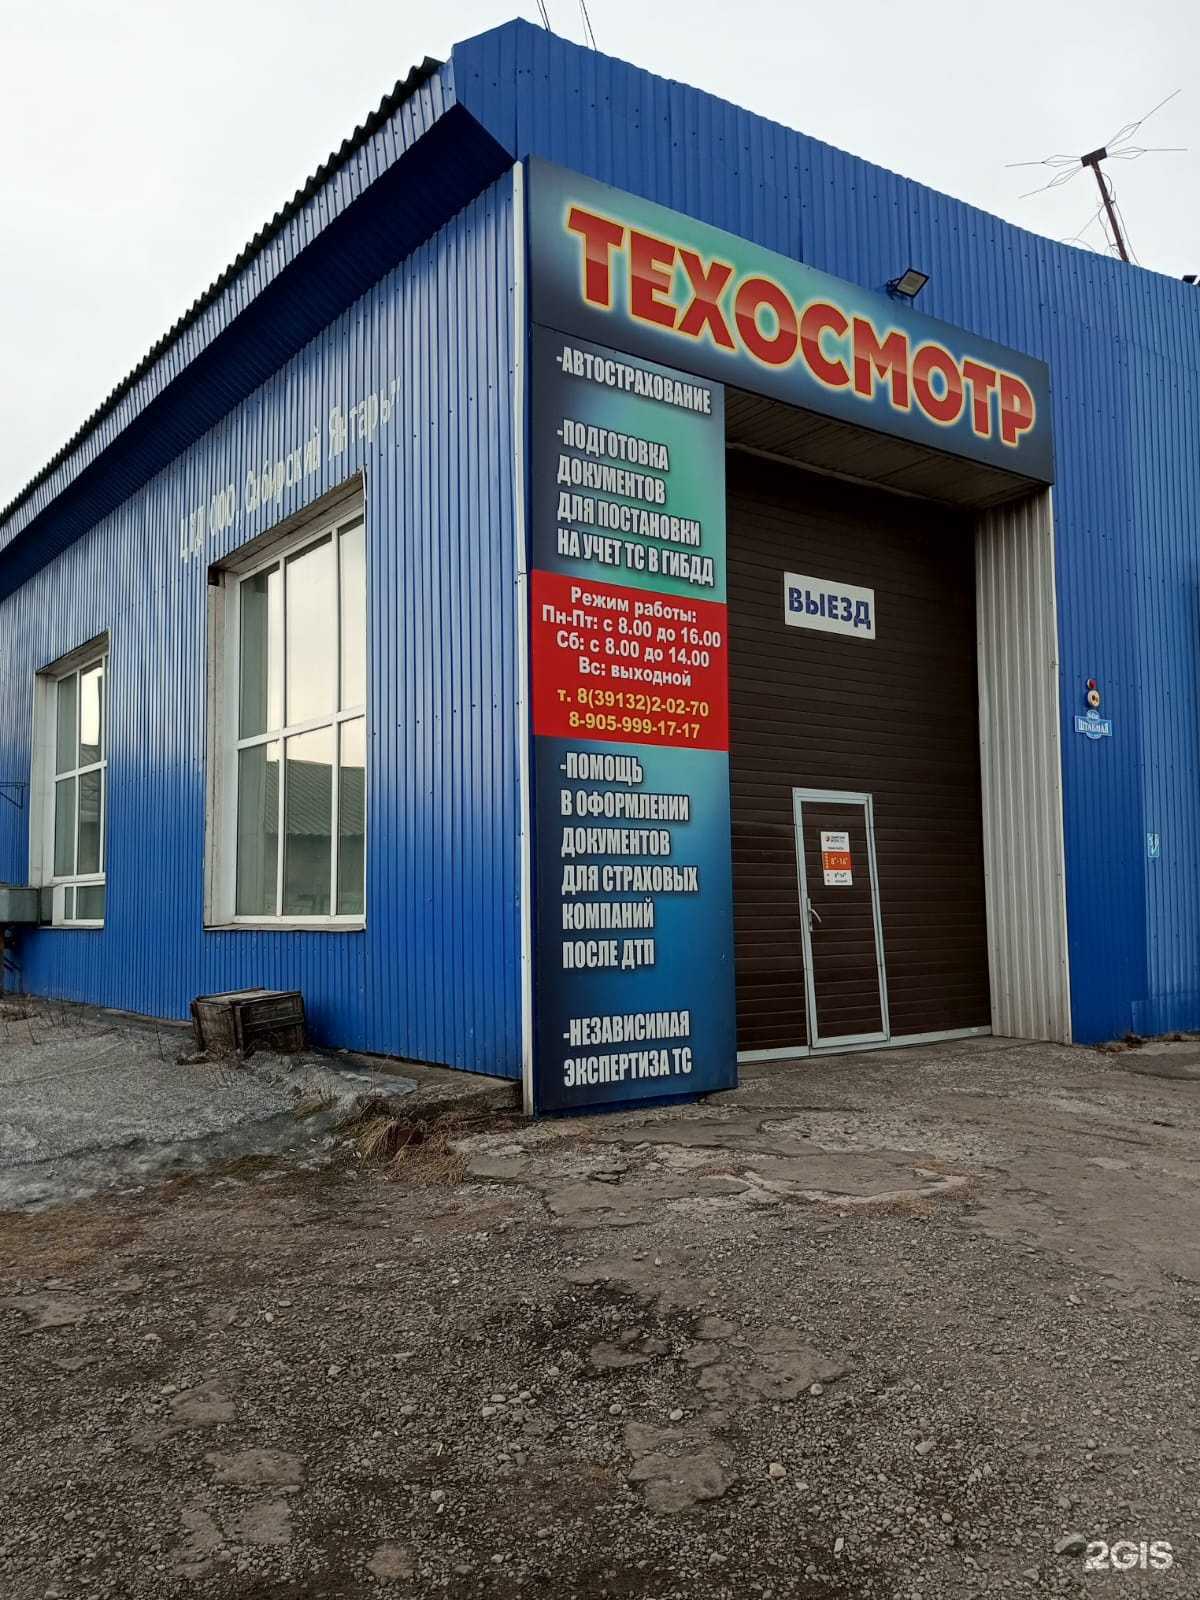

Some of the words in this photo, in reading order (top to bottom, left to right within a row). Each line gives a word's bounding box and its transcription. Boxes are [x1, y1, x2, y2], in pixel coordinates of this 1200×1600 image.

[565, 204, 1035, 446] ТЕХОСМОТР
[556, 346, 712, 415] -АВТОСТРАХОВАНИЕ
[556, 418, 670, 471] -ПОДГОТОВКА
[557, 454, 666, 504] ДОКУМЕНТОВ
[557, 492, 594, 524] ДЛЯ
[598, 499, 701, 547] ПОСТАНОВКИ
[557, 528, 580, 558] НА
[582, 533, 622, 566] УЧЕТ
[625, 542, 645, 571] ТС
[648, 547, 659, 573] В
[662, 550, 715, 587] ГИБДД
[571, 586, 629, 613] Режим
[634, 601, 697, 623] работы:
[788, 586, 872, 631] ВЫЕЗД
[542, 604, 598, 630] Пн-Пт:
[603, 619, 613, 632] с
[618, 617, 652, 638] 8.00
[656, 629, 676, 644] до
[680, 626, 722, 648] 16.00
[556, 630, 584, 651] Сб:
[590, 639, 600, 652] с
[605, 637, 640, 658] 8.00
[644, 648, 664, 664] до
[669, 647, 710, 668] 14.00
[578, 656, 606, 676] Вс:
[611, 664, 692, 687] выходной
[557, 689, 572, 703] т.
[577, 687, 709, 717] 8(39132)2-02-70
[568, 711, 701, 739] 8-905-999-17-17
[560, 752, 644, 786] -ПОМОЩЬ
[560, 789, 572, 816] В
[576, 790, 690, 821] ОФОРМЛЕНИИ
[561, 827, 671, 857] ДОКУМЕНТОВ
[561, 865, 598, 895] ДЛЯ
[602, 865, 699, 892] СТРАХОВЫХ
[562, 897, 654, 930] КОМПАНИЙ
[562, 940, 618, 968] ПОСЛЕ
[621, 939, 655, 969] ДТП
[562, 1010, 690, 1046] -НЕЗАВИСИМАЯ
[563, 1048, 670, 1087] ЭКСПЕРТИЗА
[671, 1047, 693, 1074] ТС
